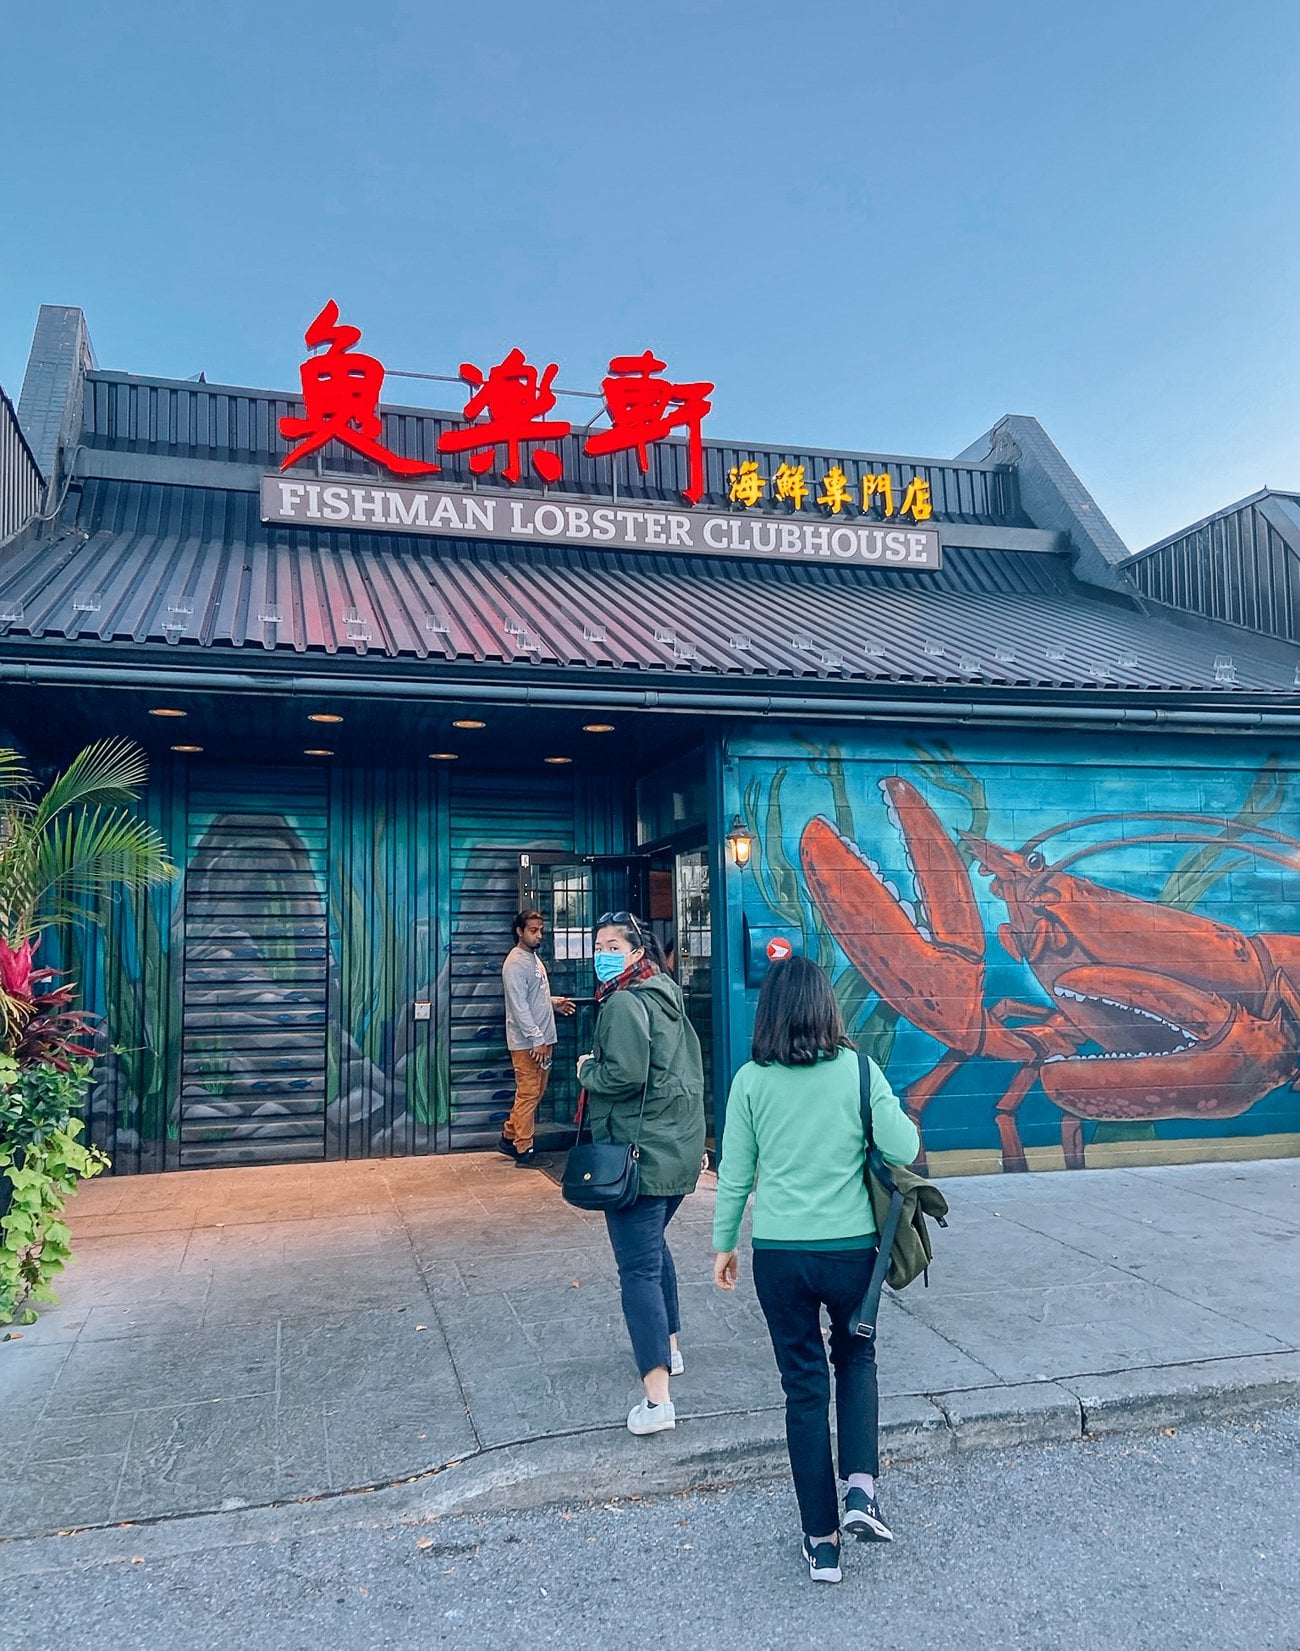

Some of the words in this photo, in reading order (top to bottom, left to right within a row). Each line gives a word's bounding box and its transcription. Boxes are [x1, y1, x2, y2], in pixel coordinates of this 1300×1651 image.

[278, 482, 497, 532] FISHMAN
[510, 502, 694, 547] LOBSTER
[703, 518, 928, 563] CLUBHOUSE
